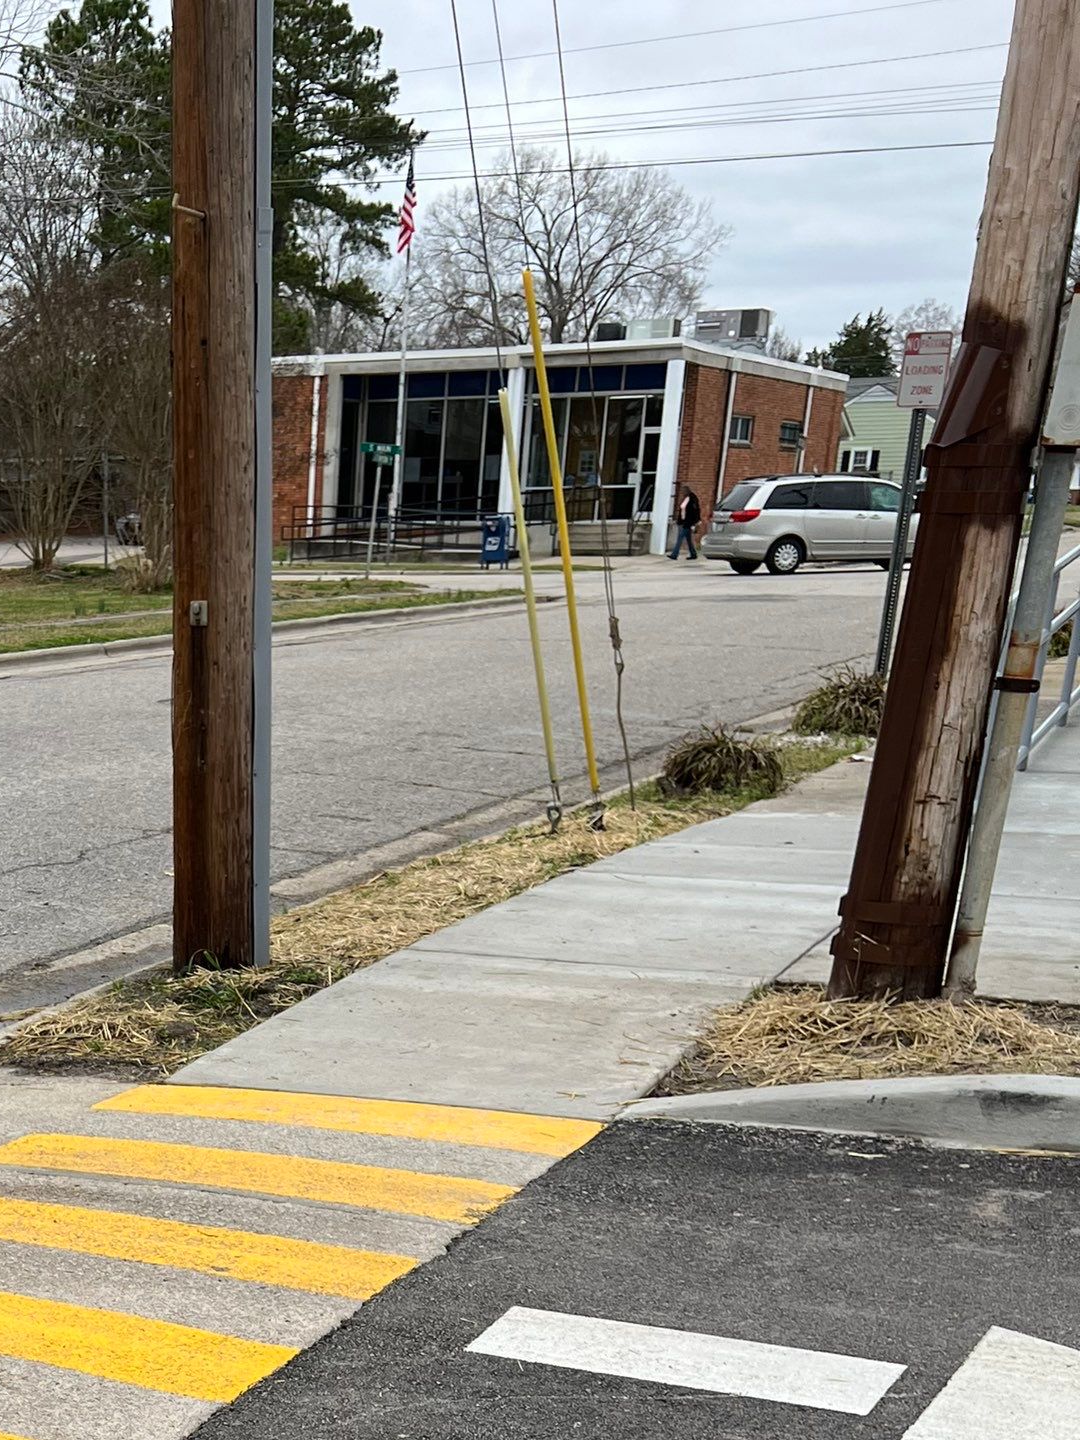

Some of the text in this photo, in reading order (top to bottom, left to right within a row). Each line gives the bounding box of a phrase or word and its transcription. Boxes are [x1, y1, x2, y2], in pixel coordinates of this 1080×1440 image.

[905, 337, 920, 352] NO
[905, 365, 944, 375] LOADING
[910, 385, 933, 395] ZONE
